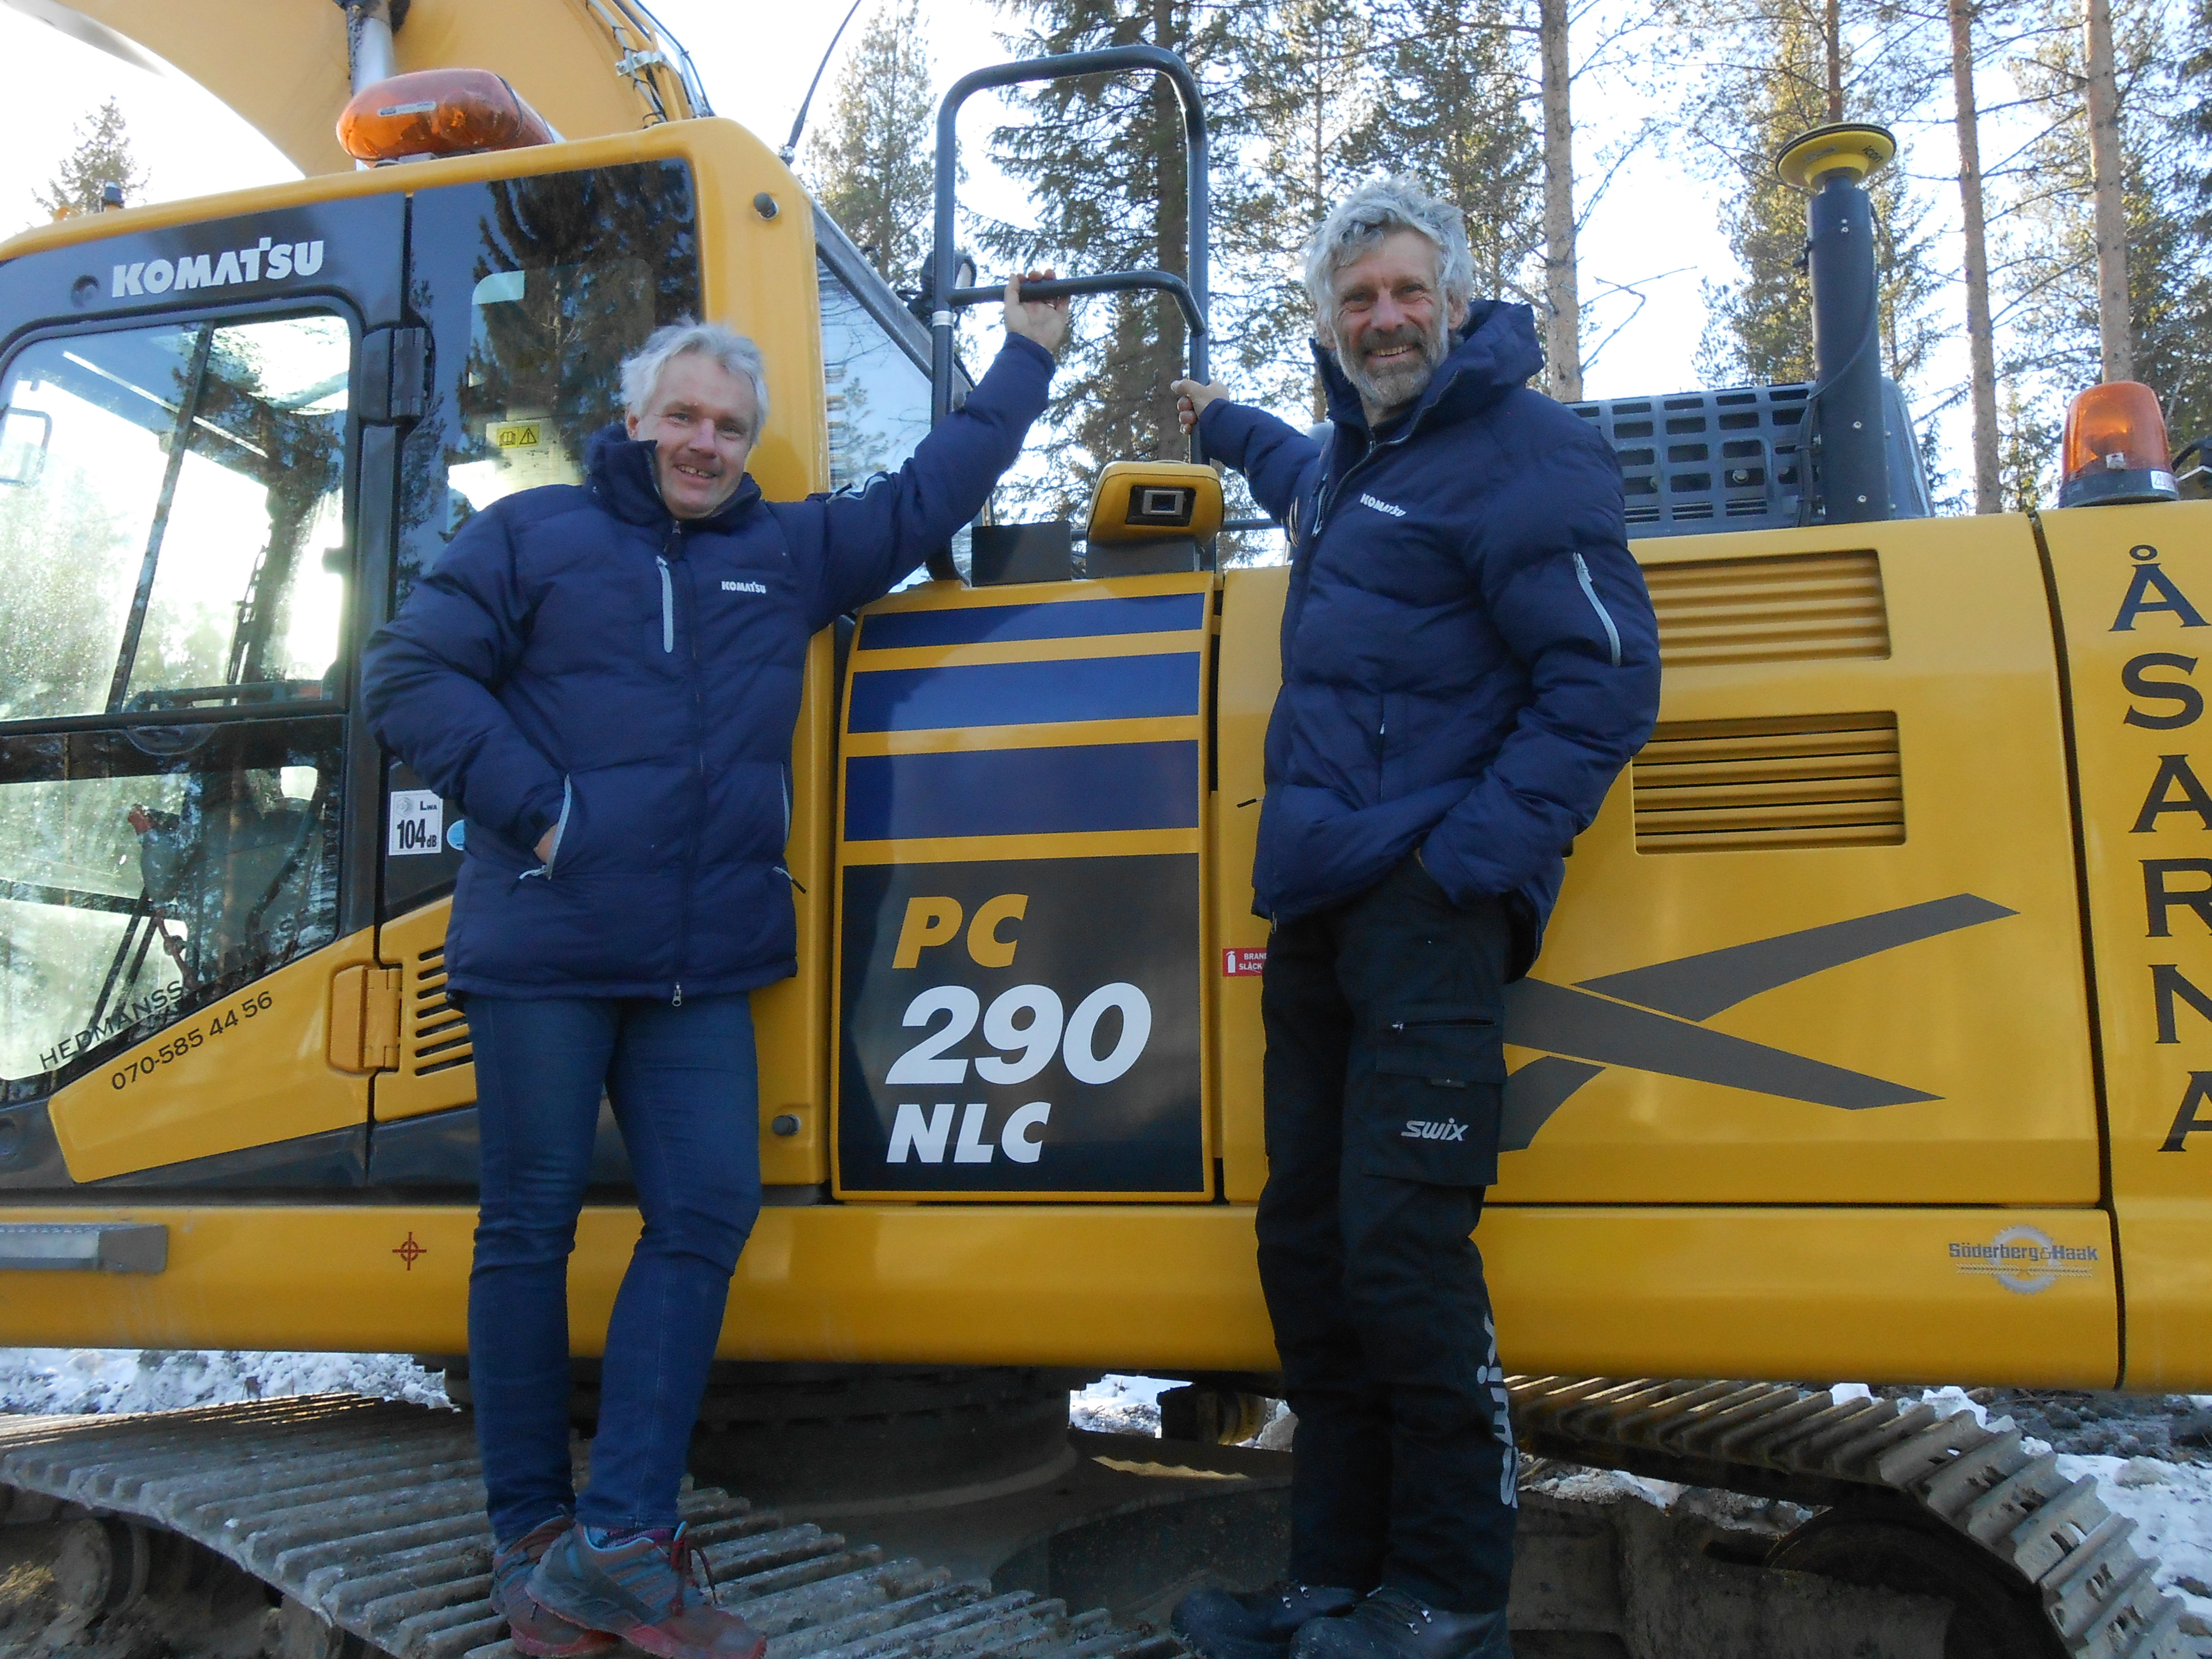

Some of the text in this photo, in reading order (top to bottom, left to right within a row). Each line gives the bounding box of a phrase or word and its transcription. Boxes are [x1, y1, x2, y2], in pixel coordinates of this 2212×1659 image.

[112, 238, 324, 298] KOMATSU
[1359, 493, 1407, 517] KOMATSU
[721, 580, 767, 594] KOMATSU
[892, 893, 1029, 969] PC
[111, 991, 273, 1091] 070-585 44 56
[885, 982, 1152, 1085] 290
[886, 1101, 1051, 1164] NLC
